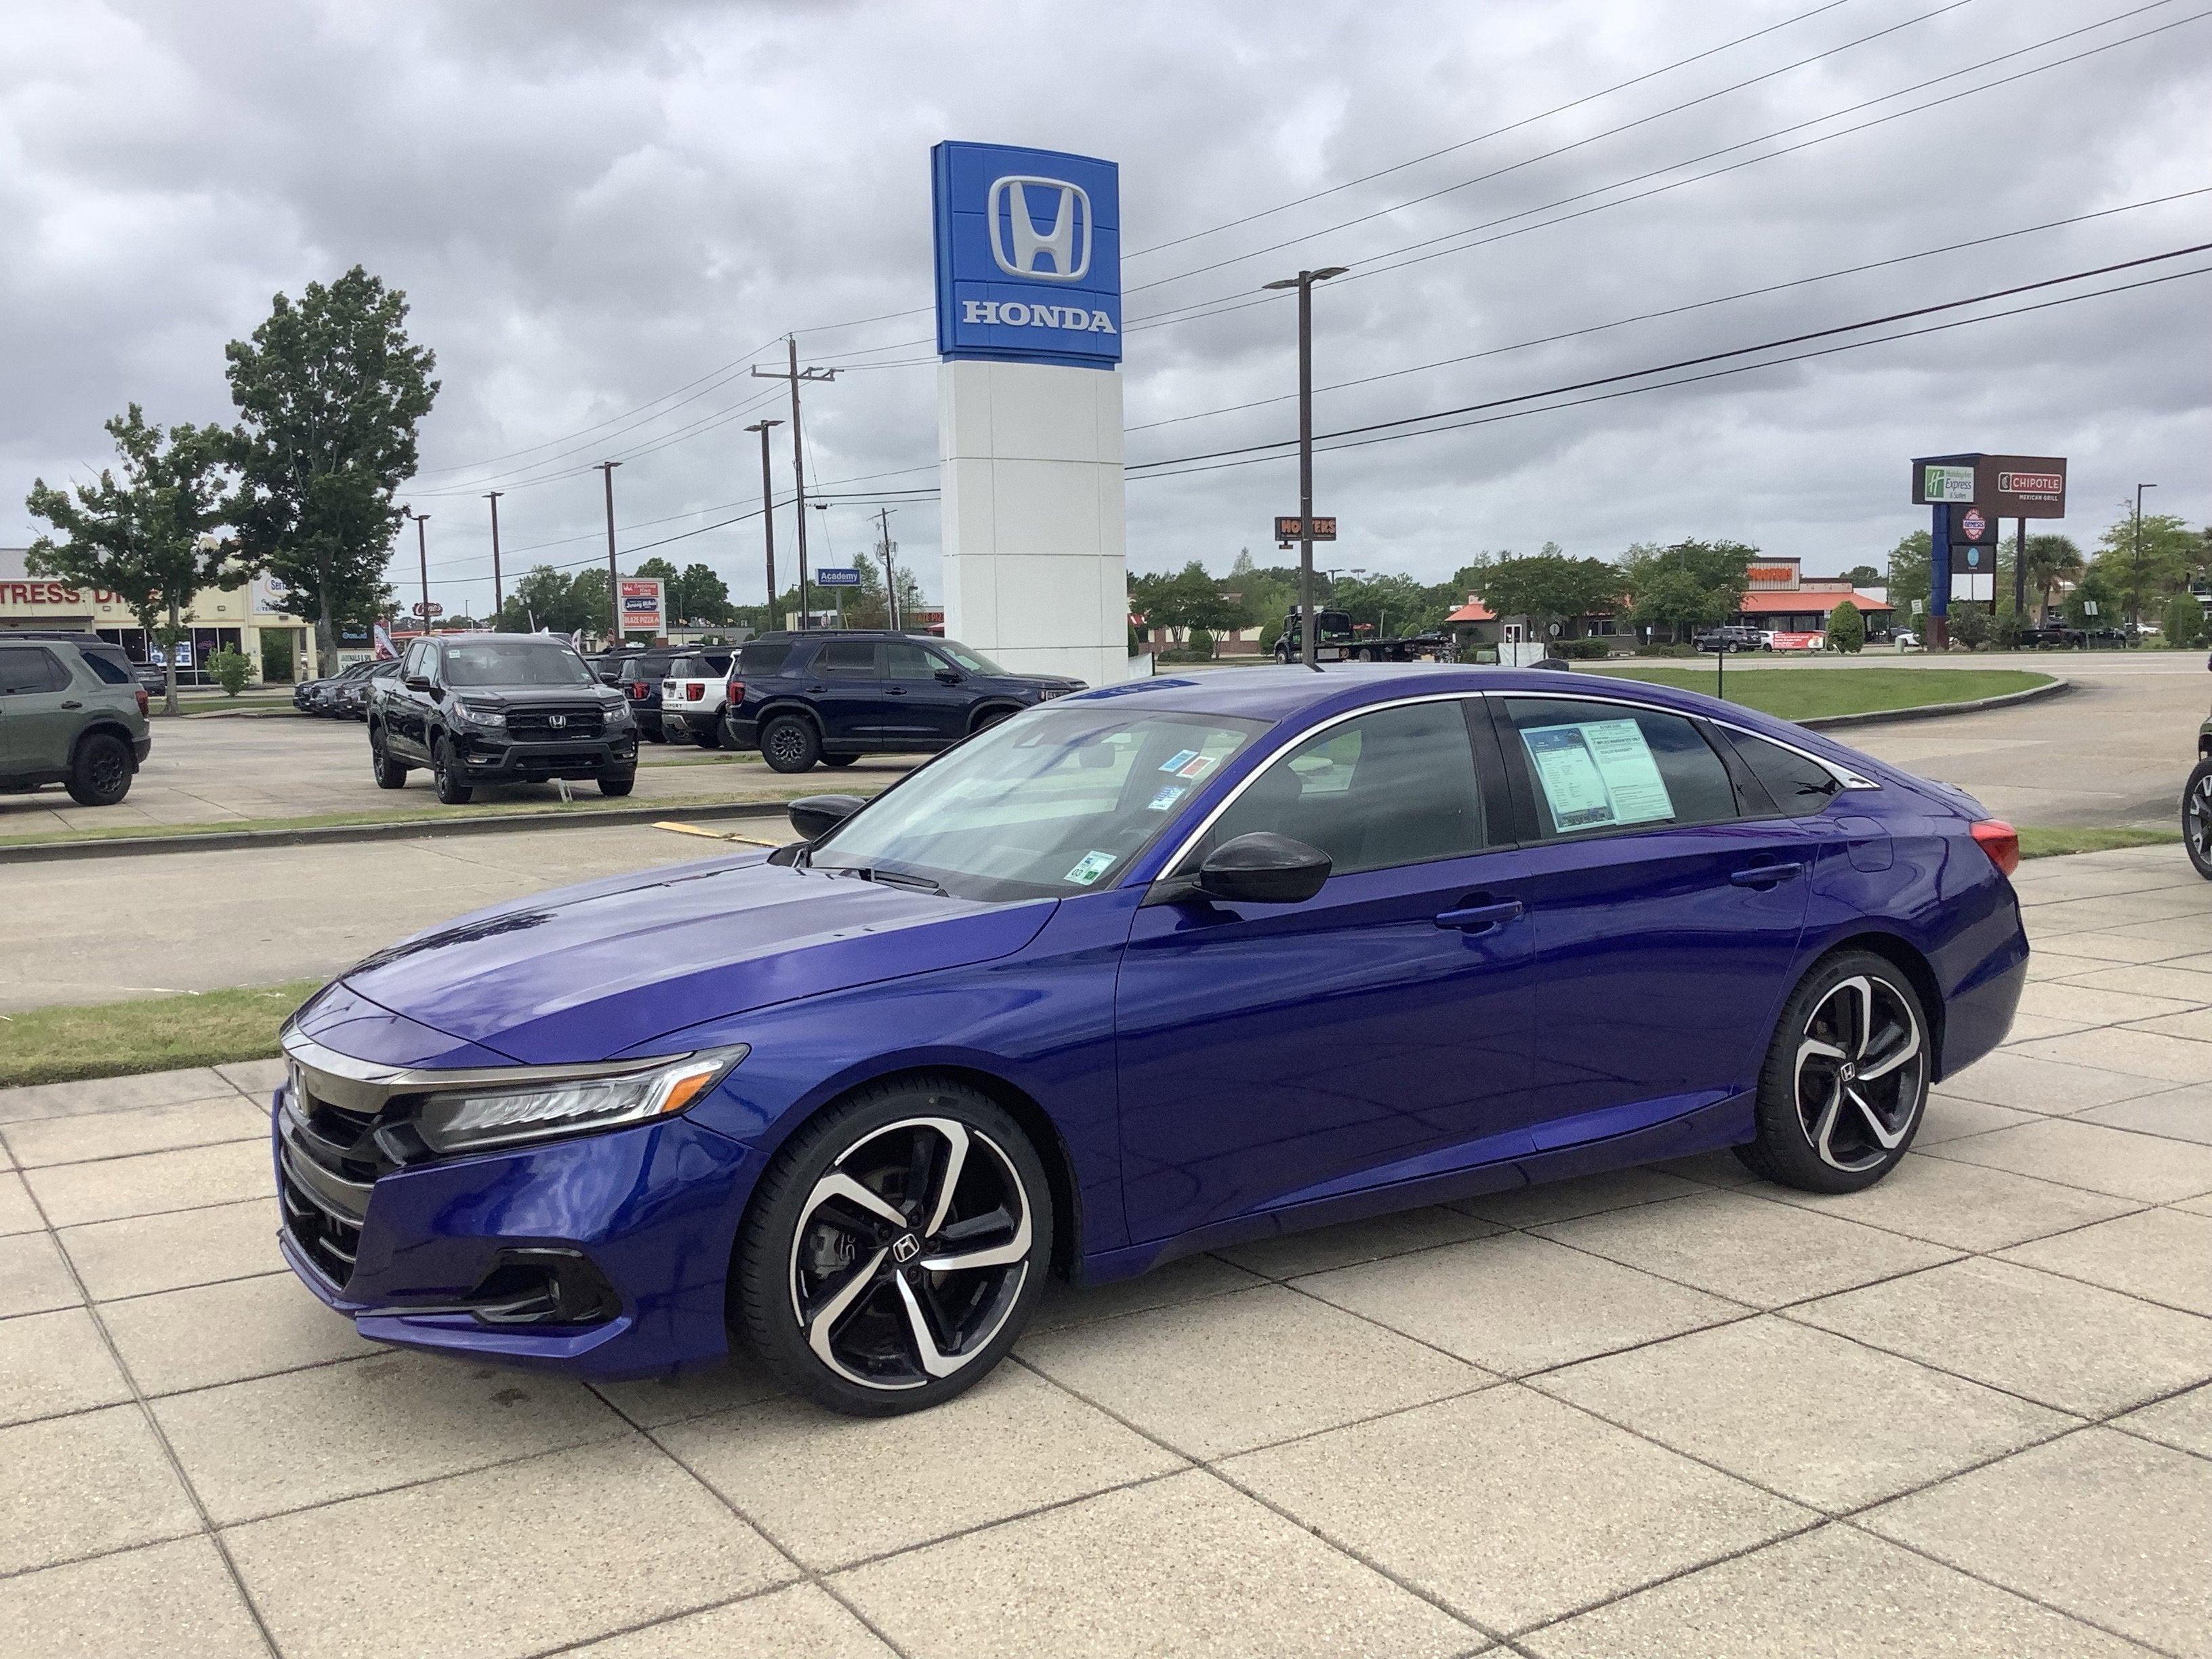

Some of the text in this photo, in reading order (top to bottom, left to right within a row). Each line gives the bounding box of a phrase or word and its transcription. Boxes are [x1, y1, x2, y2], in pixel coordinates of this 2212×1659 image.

[962, 301, 1117, 334] HONDA
[1946, 478, 1971, 491] Express
[2013, 478, 2059, 489] CHIPOTLE
[1281, 520, 1336, 533] HOERS
[821, 572, 858, 581] Academy
[1071, 868, 1084, 876] 03
